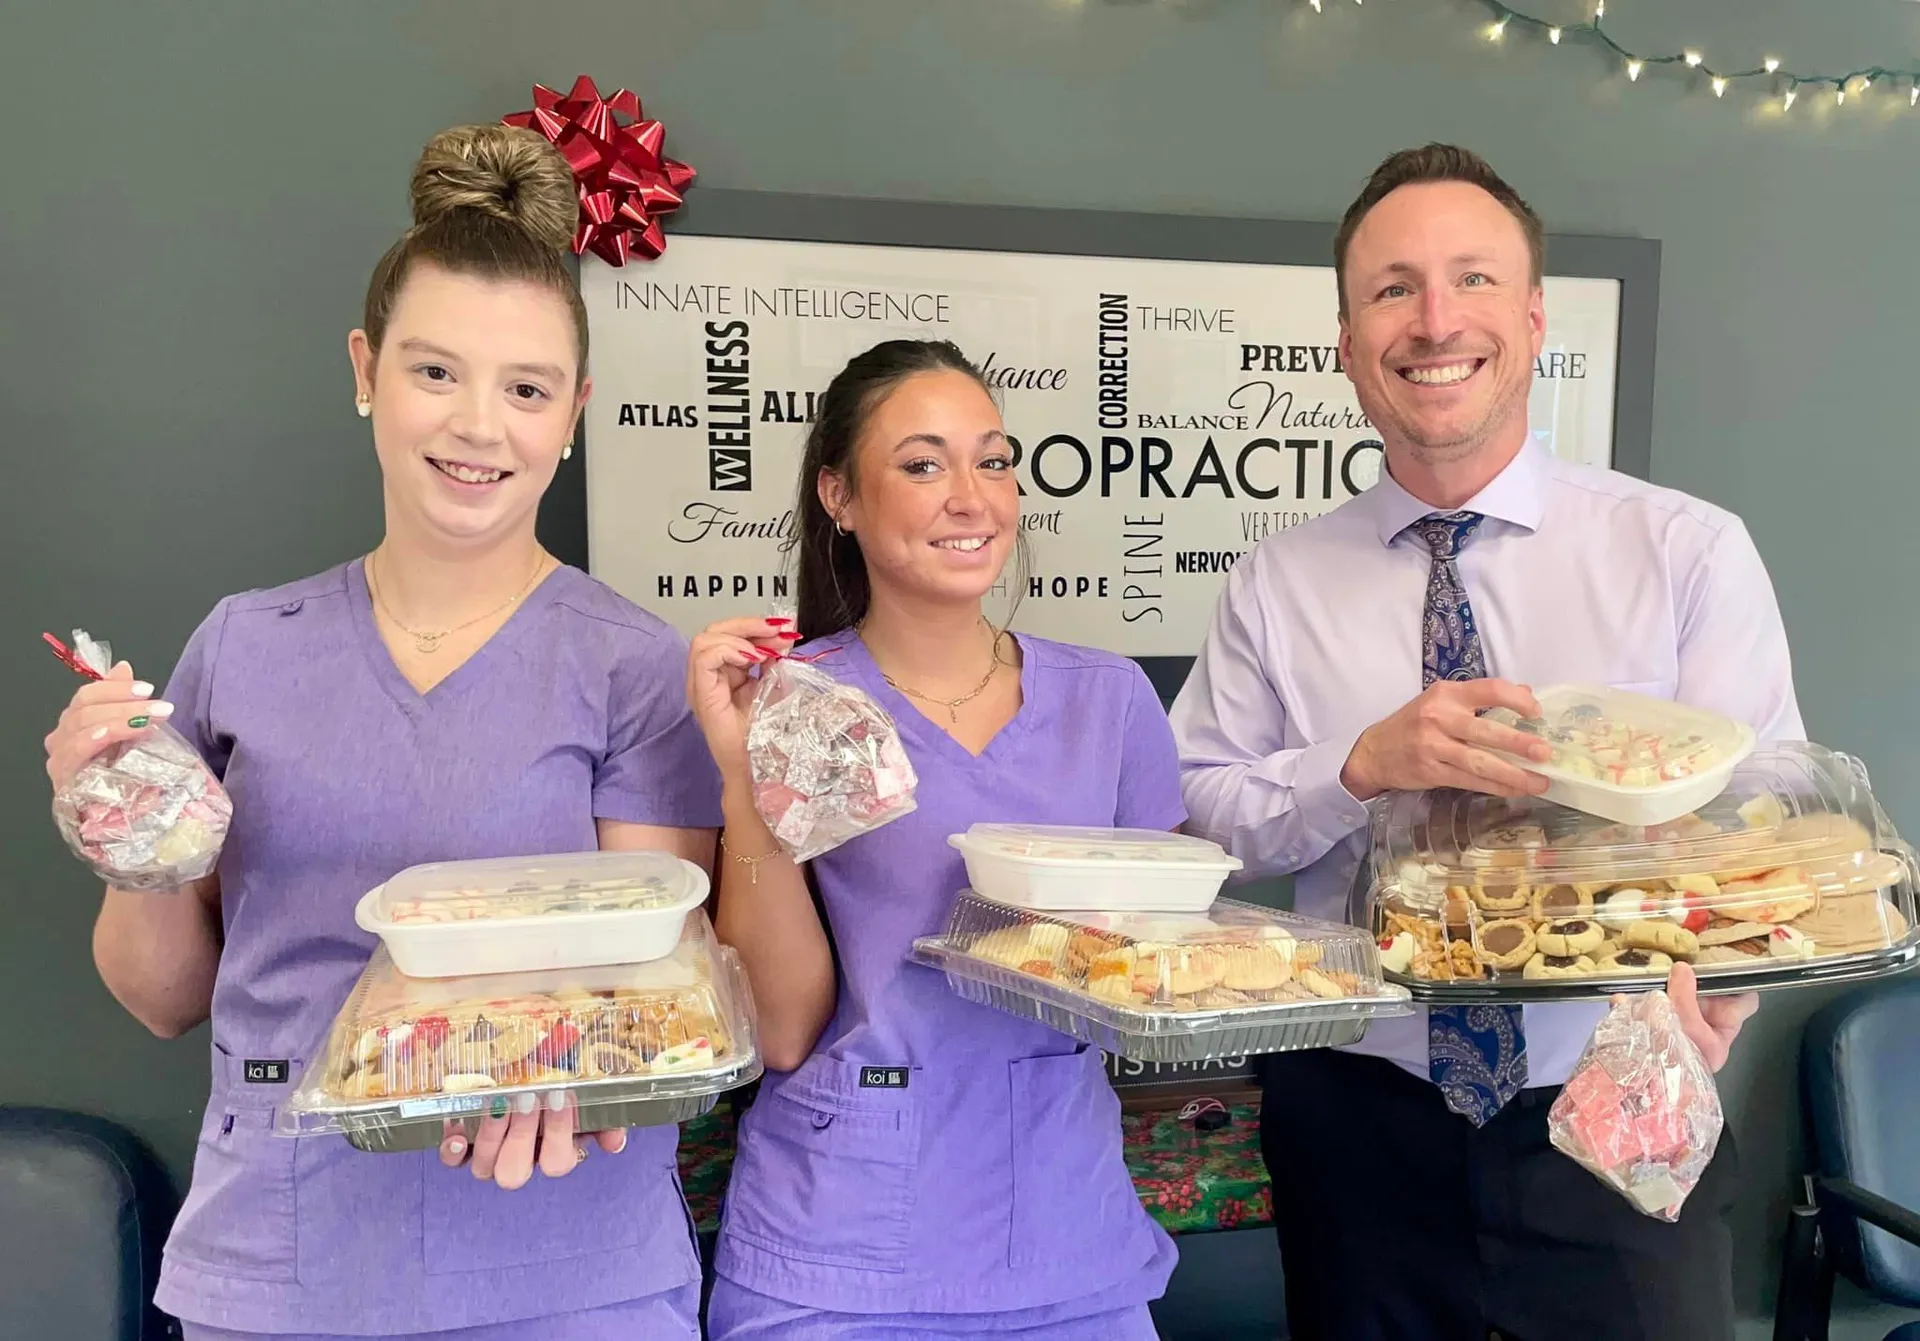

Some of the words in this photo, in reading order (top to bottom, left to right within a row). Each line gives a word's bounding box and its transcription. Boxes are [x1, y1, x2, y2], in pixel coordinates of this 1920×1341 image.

[616, 281, 730, 315] INNATE
[744, 287, 950, 322] INTELLIGENCE
[1136, 306, 1235, 333] THRIVE
[1098, 293, 1129, 430] CORRECTION
[618, 403, 699, 428] ATLAS
[705, 320, 752, 491] WELLNESS
[761, 391, 826, 424] ALI
[1138, 413, 1249, 431] BALANCE
[667, 502, 802, 553] Family
[1122, 512, 1165, 624] SPINE
[1175, 551, 1247, 574] NERVO
[1029, 577, 1109, 598] HOPE
[867, 1070, 886, 1084] koi
